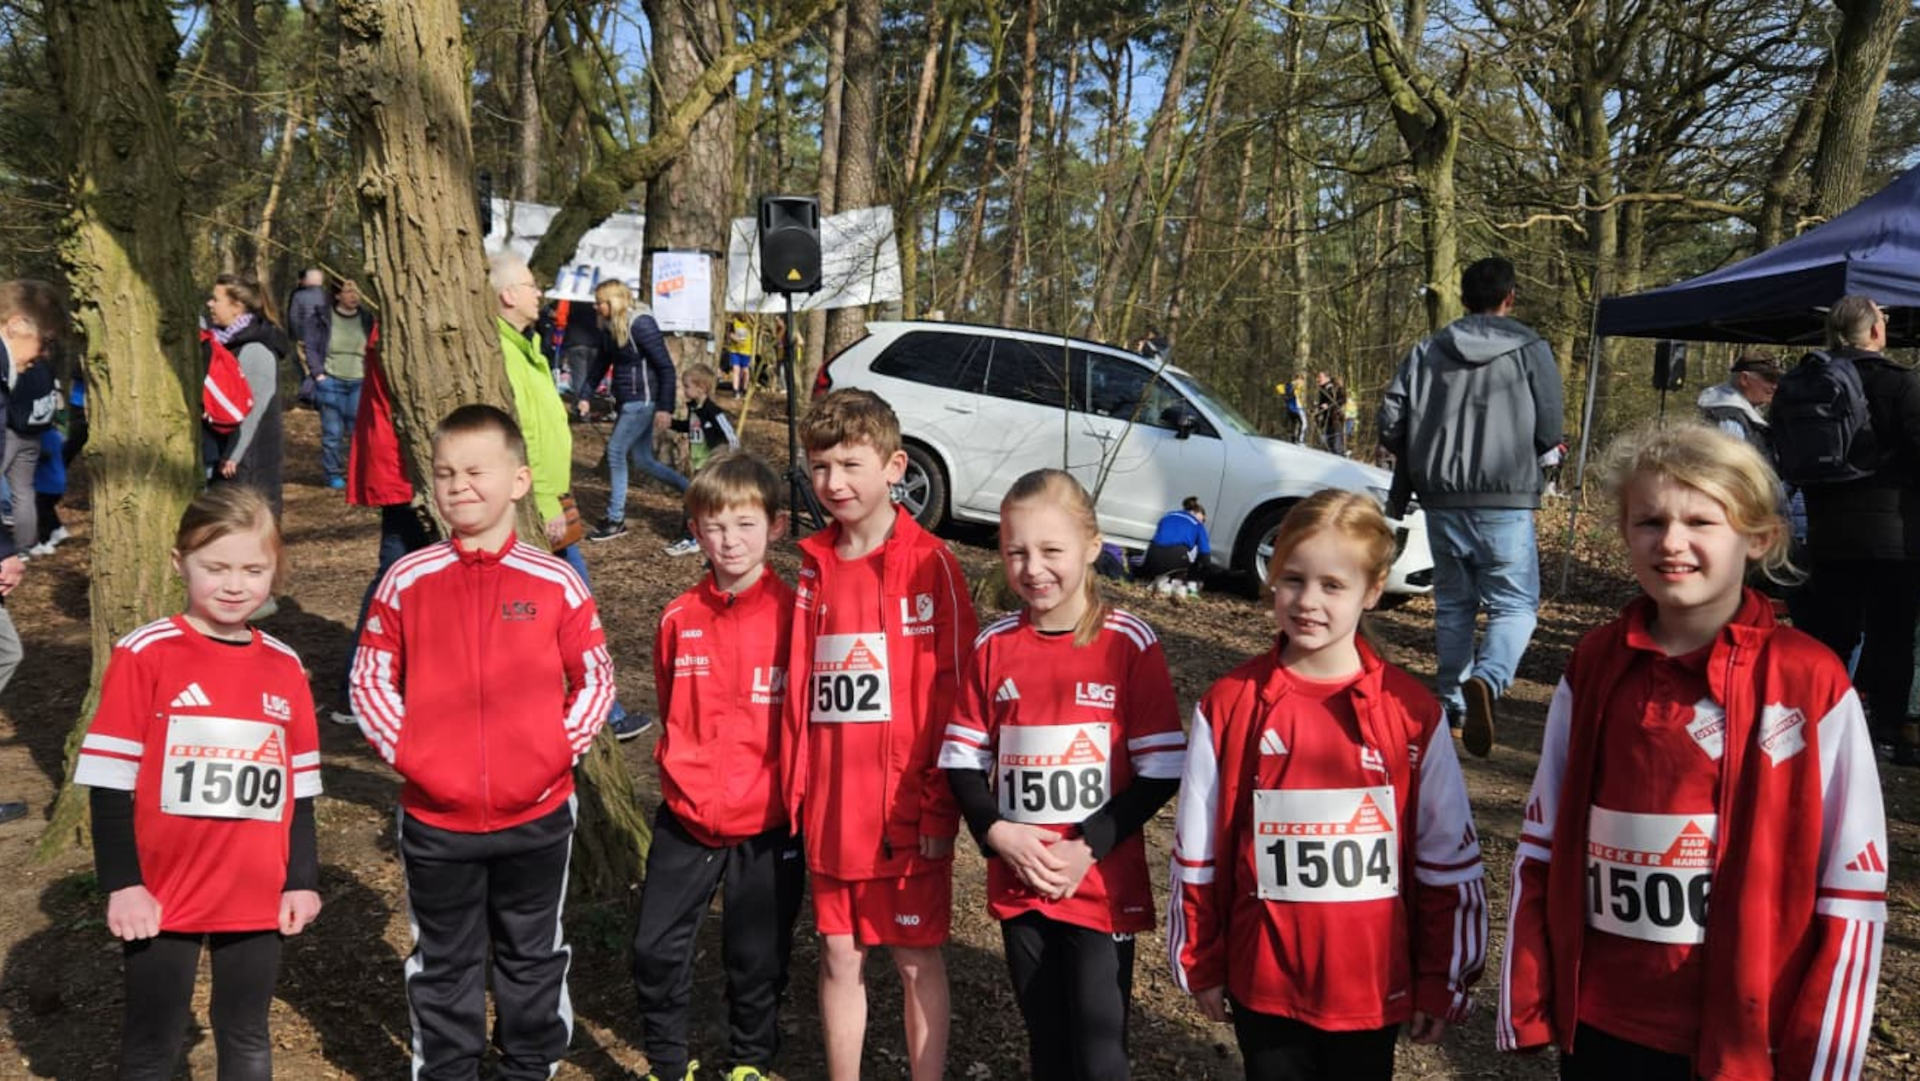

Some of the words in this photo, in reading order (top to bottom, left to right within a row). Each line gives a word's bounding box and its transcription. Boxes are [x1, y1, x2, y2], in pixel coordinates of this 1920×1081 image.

[175, 761, 282, 809] 1509
[1004, 768, 1104, 813] 1508
[1264, 823, 1347, 835] BUCKER
[1267, 838, 1391, 889] 1504
[1588, 860, 1712, 929] 1506
